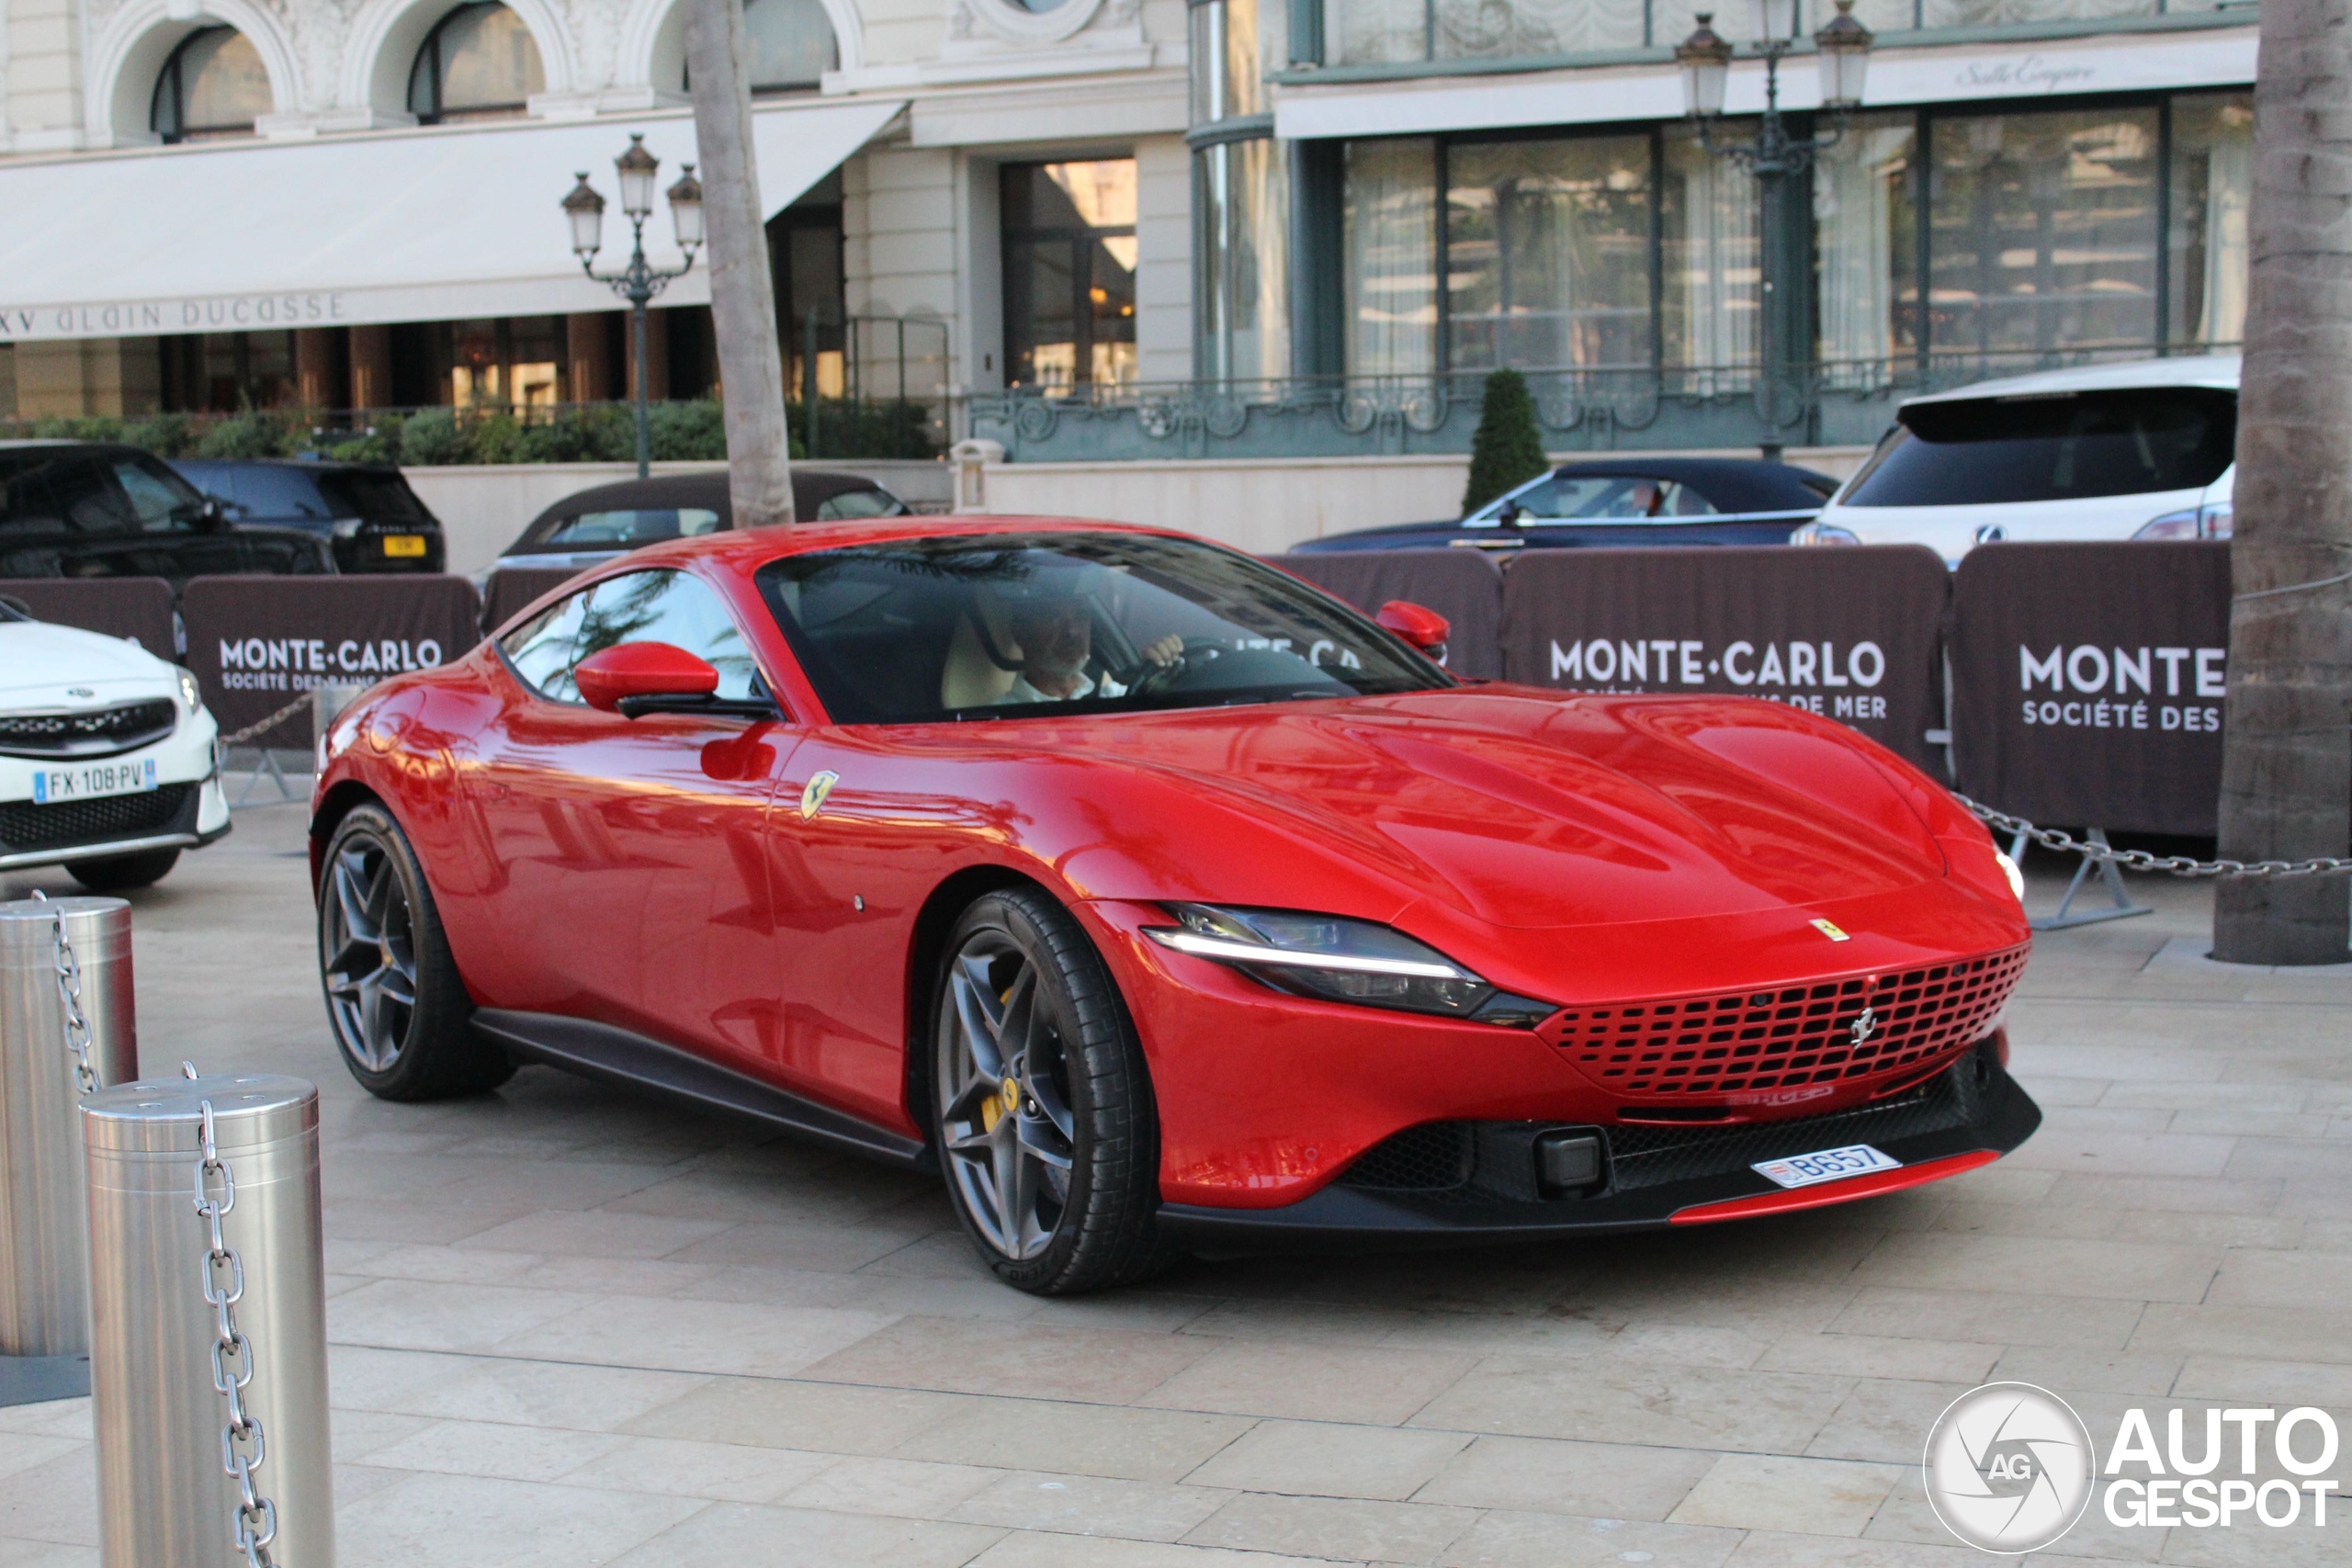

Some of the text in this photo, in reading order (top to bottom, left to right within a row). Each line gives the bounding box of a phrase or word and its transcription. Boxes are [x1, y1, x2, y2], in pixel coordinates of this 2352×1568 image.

[221, 670, 288, 691] SOCIÉTÉ
[1835, 695, 1887, 719] MER
[2022, 697, 2221, 733] SOCIÉTÉ DES
[1788, 1147, 1880, 1178] B657
